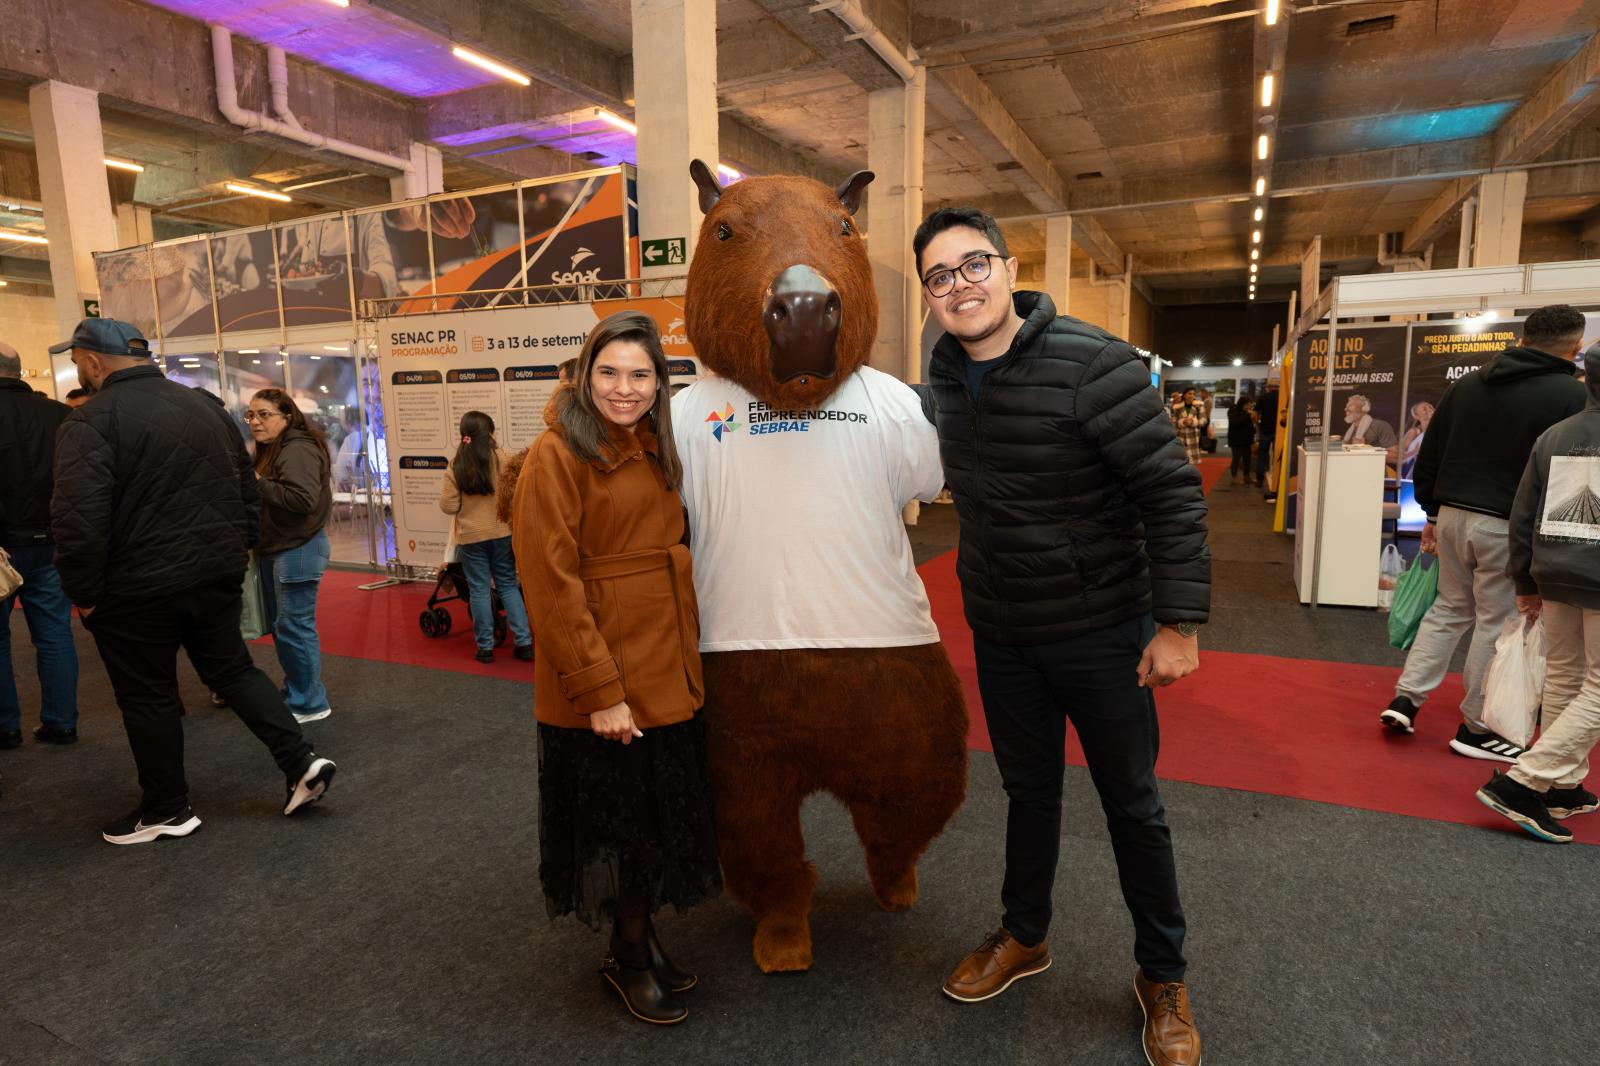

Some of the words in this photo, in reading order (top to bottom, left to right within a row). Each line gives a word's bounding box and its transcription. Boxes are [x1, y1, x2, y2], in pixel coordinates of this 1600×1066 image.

[551, 267, 600, 286] senac
[391, 330, 435, 345] SENAC
[438, 329, 456, 342] PR
[487, 338, 494, 350] 3
[497, 340, 505, 349] a
[508, 337, 519, 349] 13
[523, 335, 539, 348] de
[1344, 337, 1364, 351] NO
[1424, 335, 1447, 344] PREÇO
[1448, 333, 1470, 343] JUSTO
[1470, 333, 1475, 342] O
[1476, 332, 1493, 341] ANO
[1494, 331, 1515, 341] TODO,
[391, 343, 458, 357] PROGRAMAÇÃO
[1431, 344, 1450, 354] SEM
[1451, 341, 1506, 353] PEGADINHAS
[1309, 354, 1358, 370] OULET
[1369, 372, 1394, 383] SESC
[748, 410, 868, 424] EMPREENDEDOR
[750, 421, 810, 435] SEBRAE
